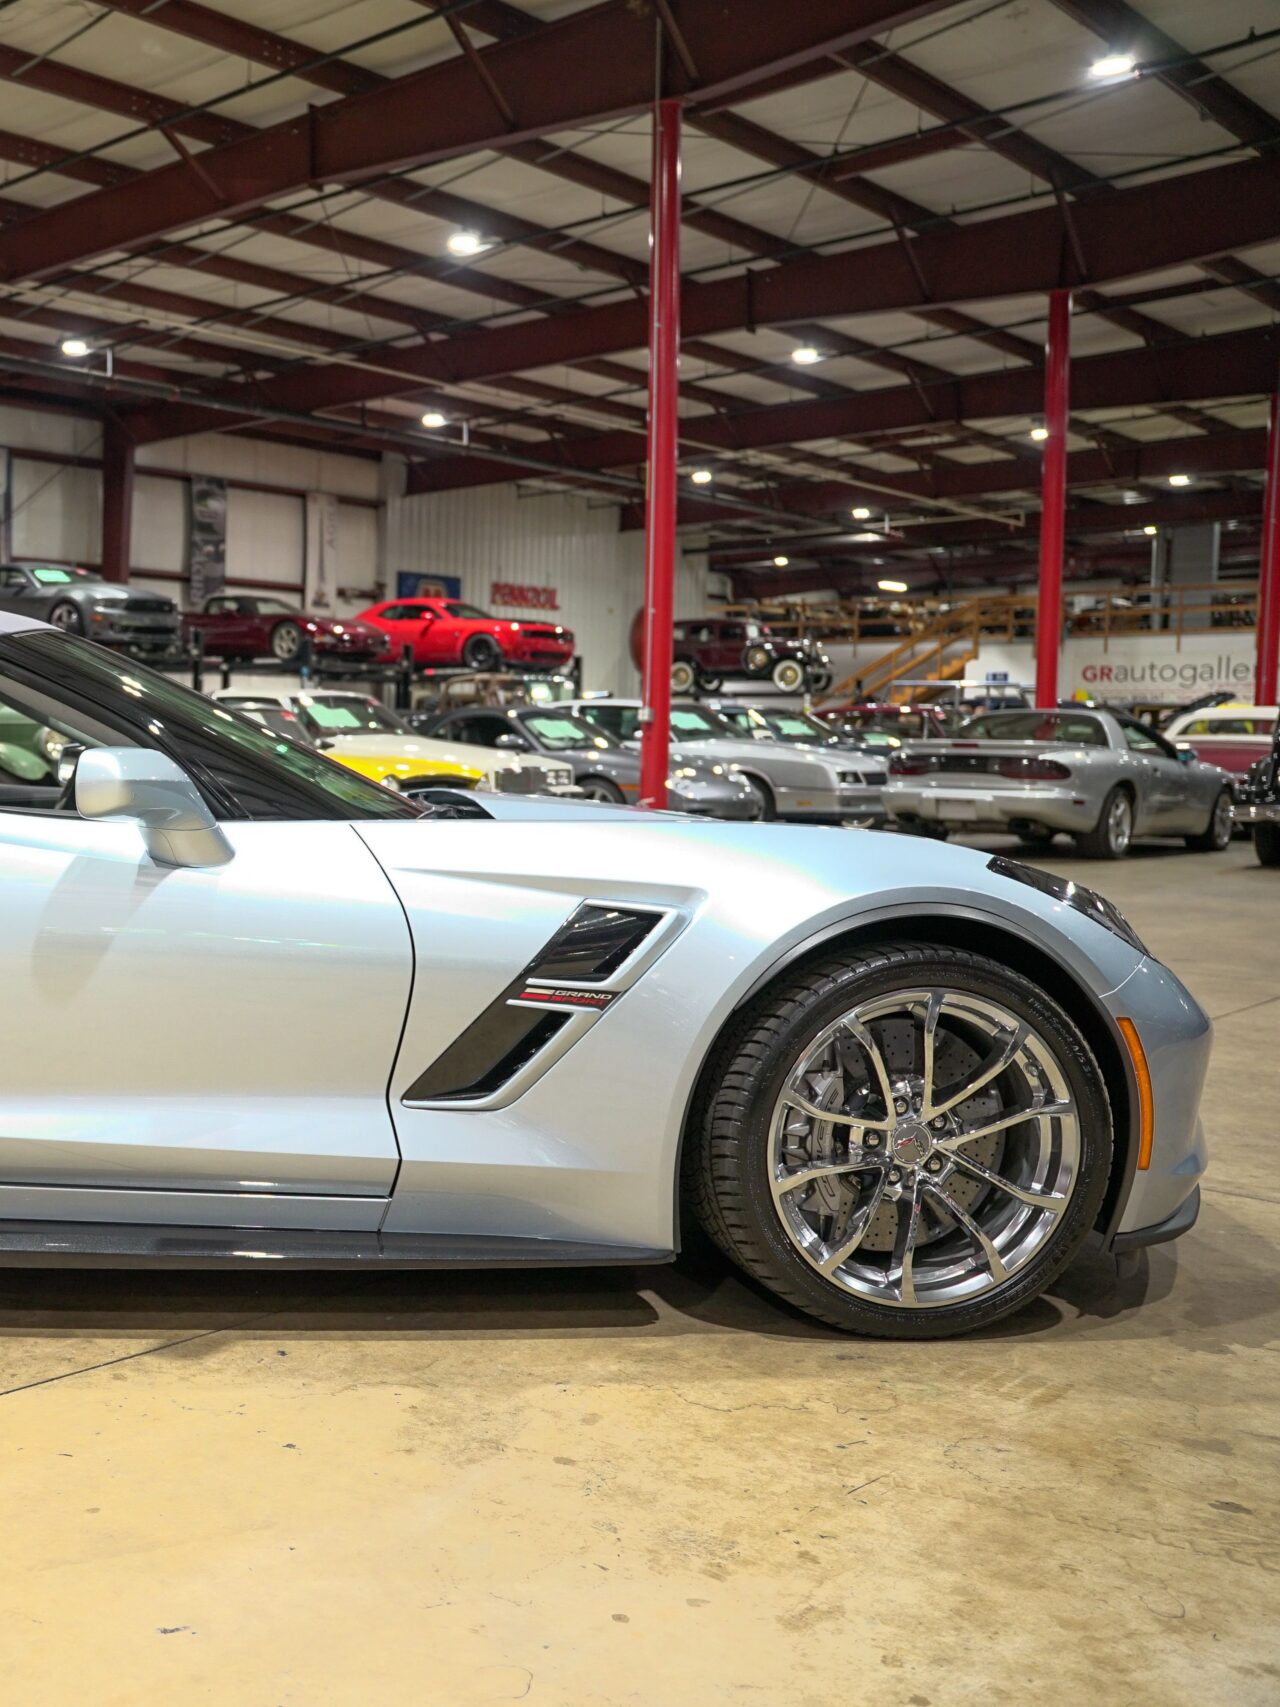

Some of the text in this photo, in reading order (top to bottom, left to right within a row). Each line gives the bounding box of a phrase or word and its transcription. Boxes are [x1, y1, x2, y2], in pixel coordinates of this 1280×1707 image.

[1082, 655, 1256, 688] GRautogalle
[551, 995, 609, 1005] SPORT
[554, 990, 613, 1000] GRAND
